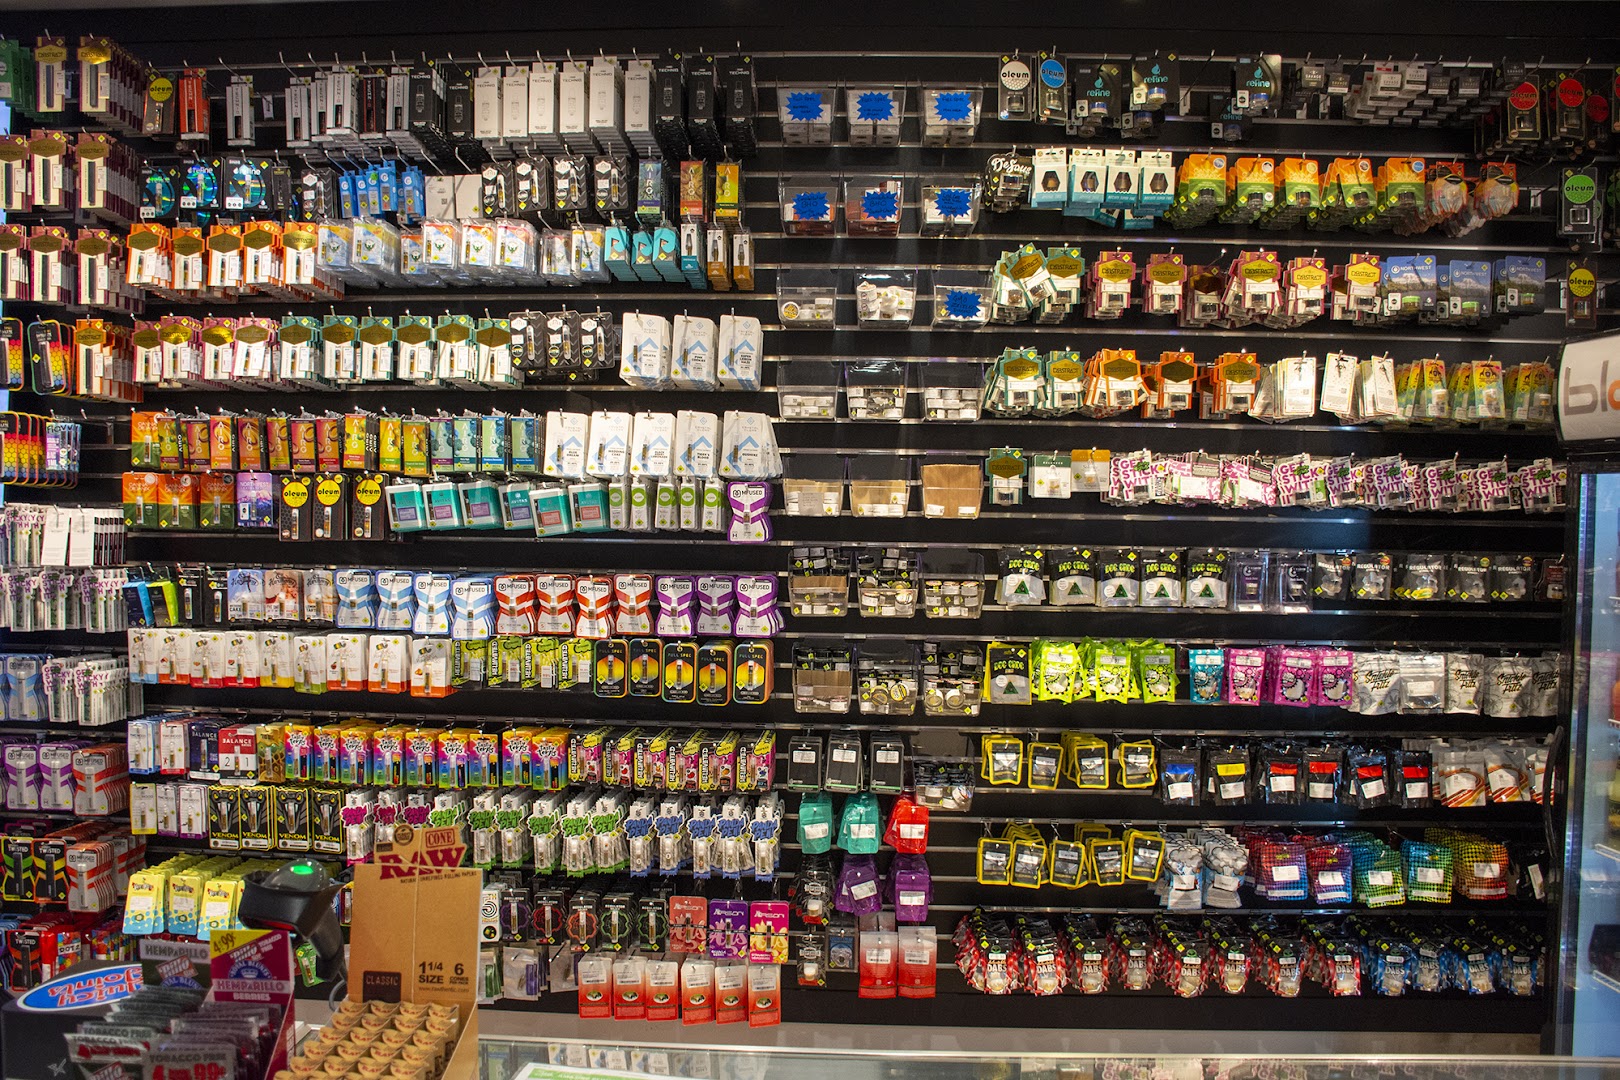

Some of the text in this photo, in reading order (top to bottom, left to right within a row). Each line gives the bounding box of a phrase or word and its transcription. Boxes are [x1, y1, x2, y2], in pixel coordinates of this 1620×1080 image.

[1001, 70, 1030, 79] oleum
[1041, 68, 1065, 78] oleum
[1143, 75, 1169, 83] refine
[1246, 79, 1270, 88] refine
[1087, 89, 1111, 97] refine
[723, 168, 731, 198] AIRO
[1565, 184, 1595, 193] oleum
[1569, 277, 1595, 286] oleum
[217, 421, 226, 452] AIRO
[352, 418, 360, 449] AIRO
[387, 422, 395, 452] AIRO
[410, 427, 419, 457] AIRO
[284, 490, 307, 498] oleum
[317, 488, 340, 496] oleum
[357, 487, 381, 496] oleum
[389, 577, 410, 585] MFUSED
[427, 581, 448, 589] MFUSED
[587, 585, 607, 593] MFUSED
[668, 583, 690, 591] MFUSED
[224, 757, 231, 767] 2
[430, 808, 459, 821] PANDA
[469, 809, 497, 821] PANDA
[497, 809, 523, 821] PANDA
[592, 812, 619, 825] PANDA
[528, 815, 556, 827] PANDA
[561, 815, 590, 828] PANDA
[624, 816, 653, 830] PANDA
[655, 813, 684, 828] PANDA
[428, 832, 453, 846] CONE
[379, 847, 466, 880] RAW
[145, 944, 209, 959] HEMPARILLO
[454, 963, 464, 976] 6
[987, 963, 1007, 974] DABS
[1036, 964, 1057, 975] DABS
[1082, 965, 1103, 975] DABS
[1180, 967, 1202, 978] DABS
[1225, 965, 1246, 974] DABS
[1279, 967, 1301, 978] DABS
[1336, 965, 1356, 976] DABS
[1385, 966, 1406, 977] DABS
[366, 975, 399, 986] CLASSIC
[418, 974, 444, 984] SIZE
[217, 980, 285, 992] HEMPARILLO
[233, 993, 272, 1002] BERRIES
[83, 1026, 130, 1036] TOBACCO
[150, 1053, 201, 1063] TOBACCO
